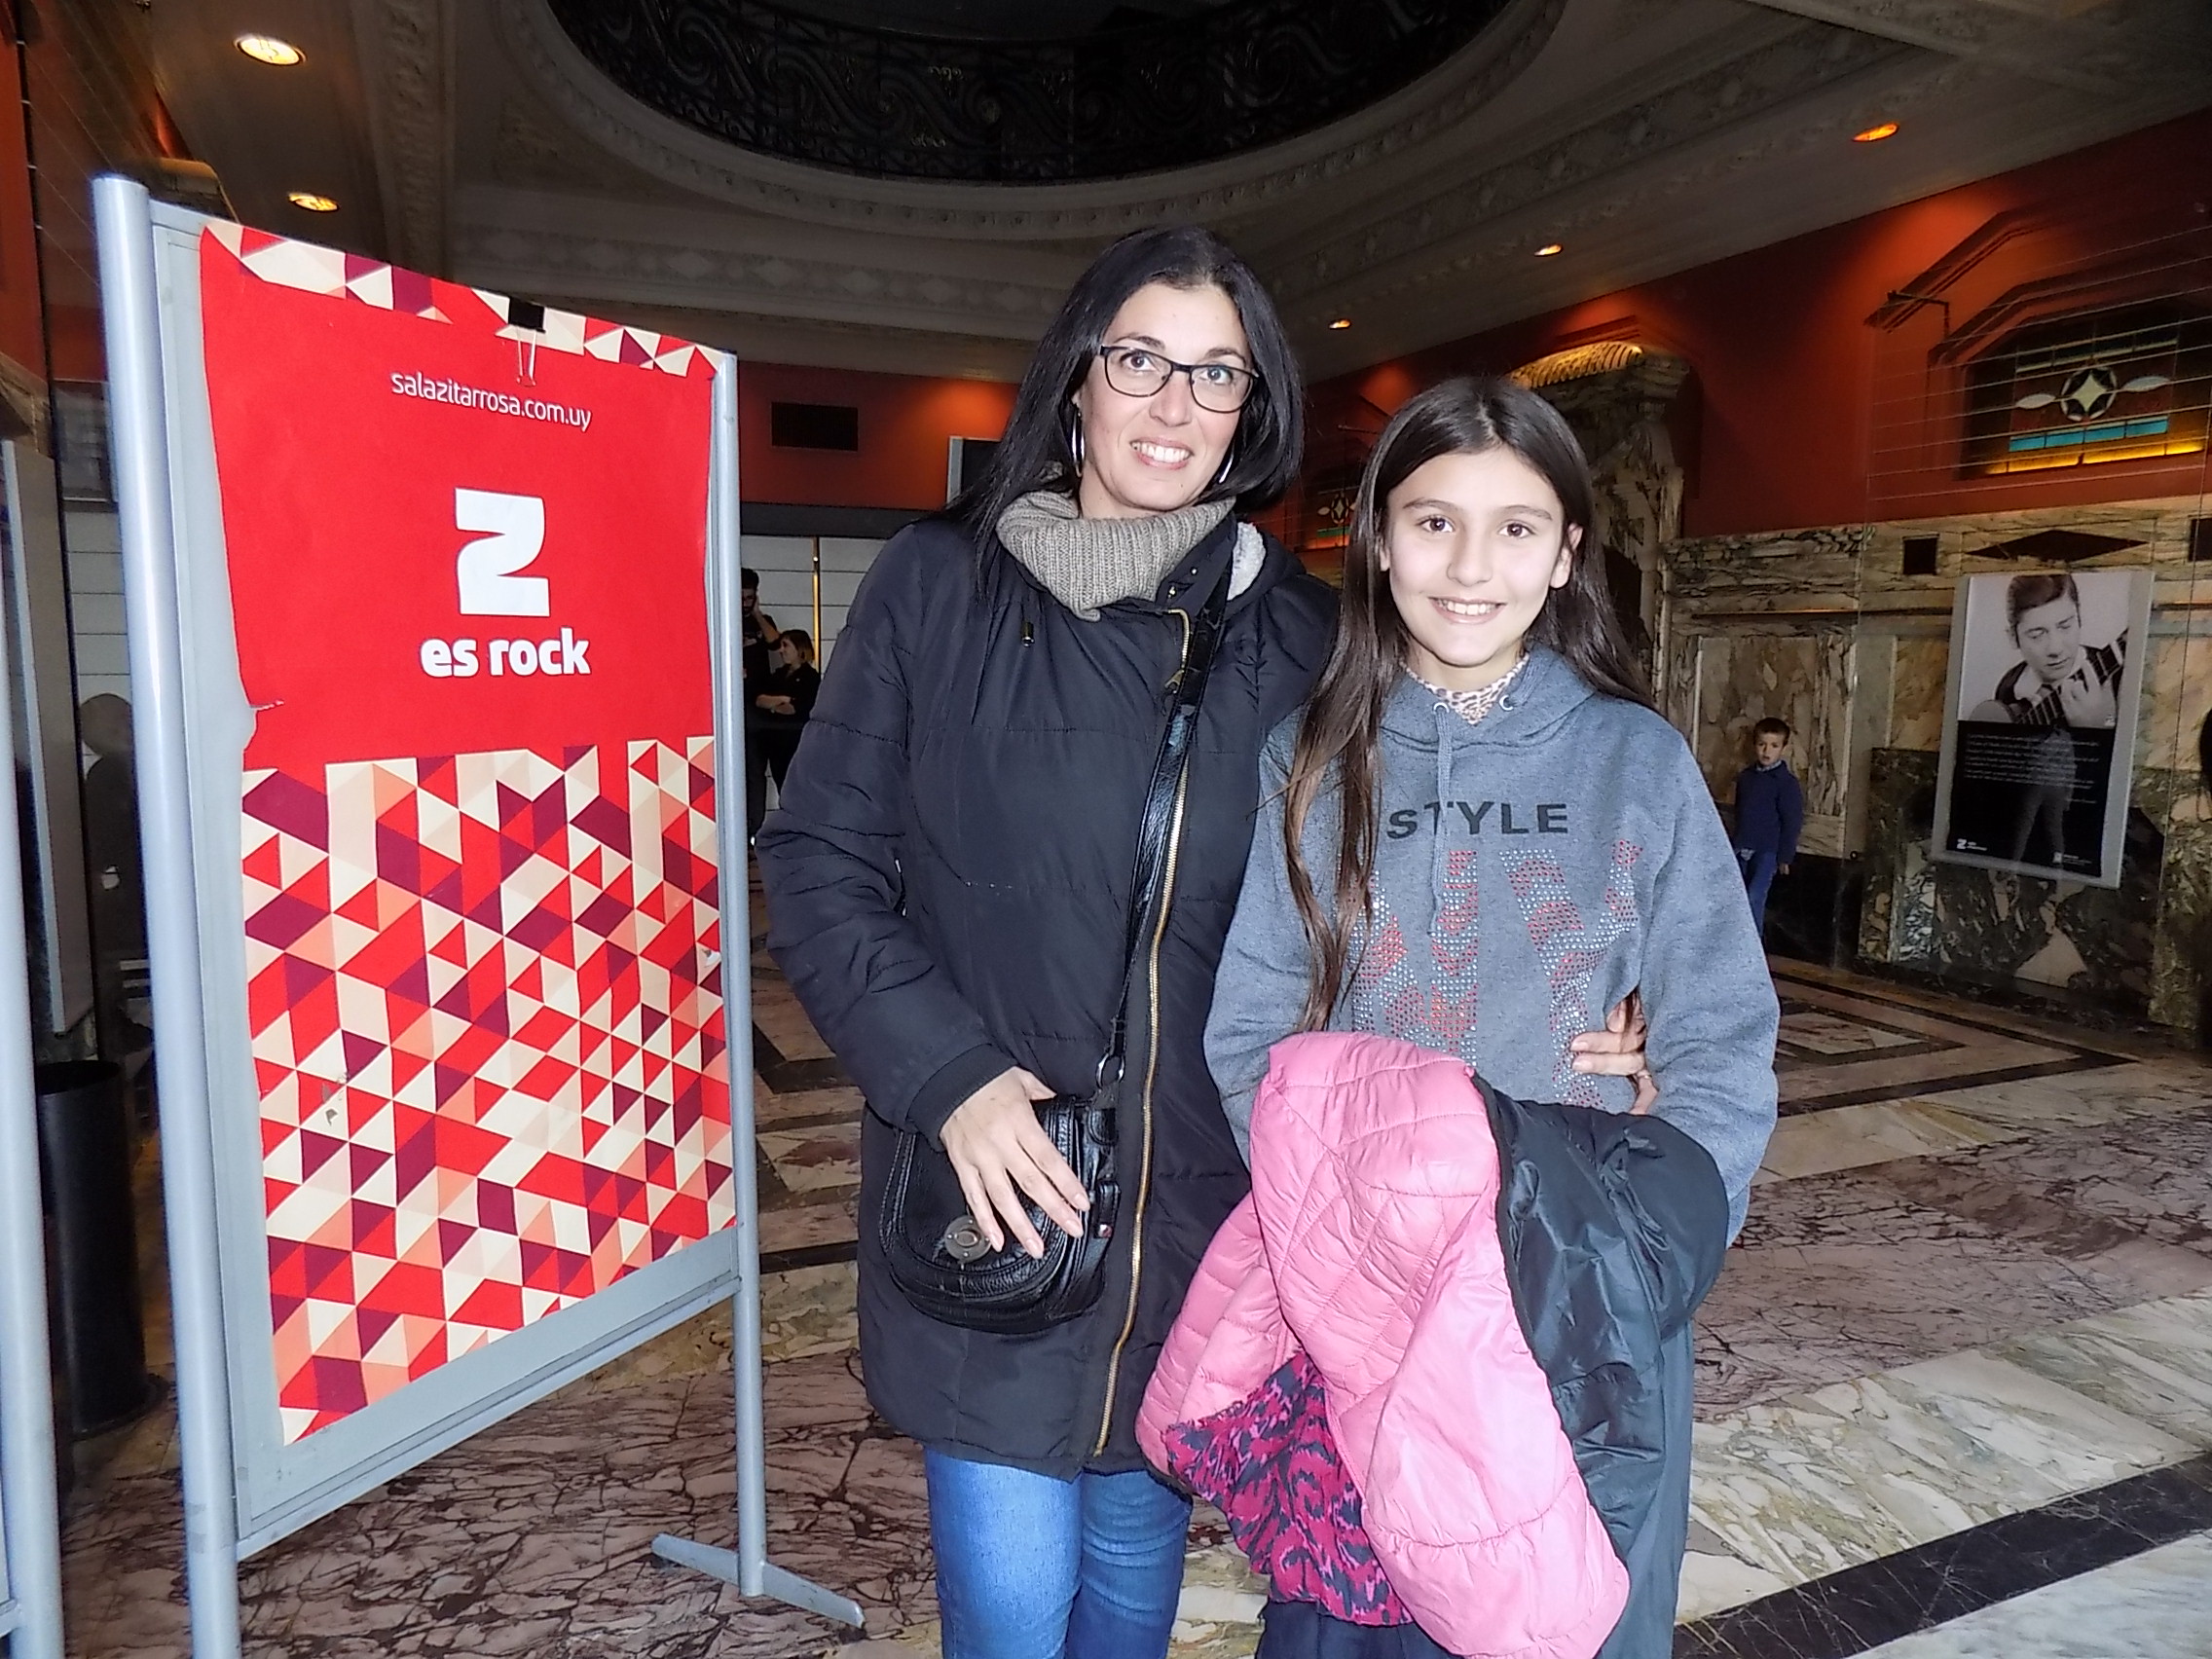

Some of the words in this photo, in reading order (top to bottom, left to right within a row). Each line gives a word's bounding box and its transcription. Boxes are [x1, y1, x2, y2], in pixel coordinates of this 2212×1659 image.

[390, 370, 592, 432] salazitarrosa.com.uy
[420, 638, 479, 678] es
[489, 626, 591, 676] rock
[1385, 800, 1569, 840] STYLE
